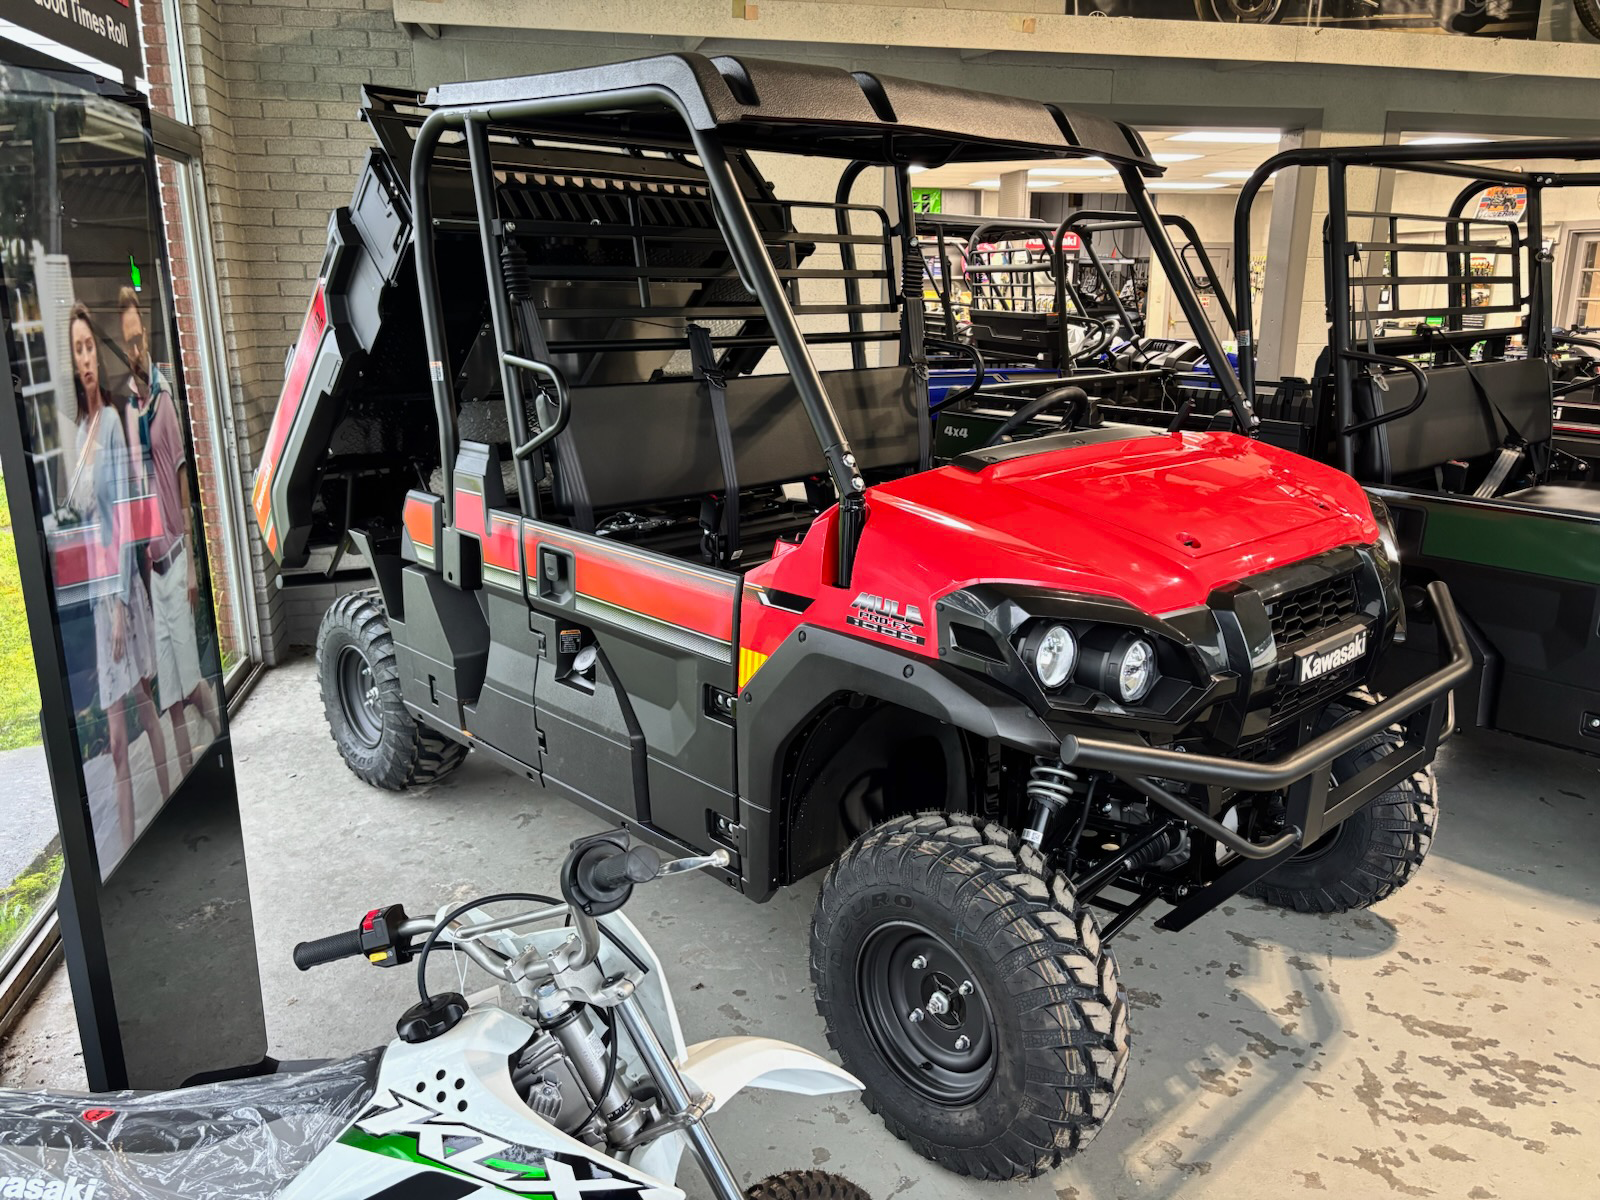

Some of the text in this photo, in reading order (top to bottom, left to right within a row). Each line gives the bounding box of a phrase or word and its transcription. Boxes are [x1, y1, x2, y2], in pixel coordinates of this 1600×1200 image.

[34, 0, 129, 48] ood Times Roll
[944, 425, 969, 439] 4x4
[850, 592, 925, 627] MULE
[858, 611, 914, 633] PRO-FX
[852, 617, 919, 643] 1000
[1300, 631, 1367, 682] Kawasaki
[355, 1089, 655, 1200] KLX
